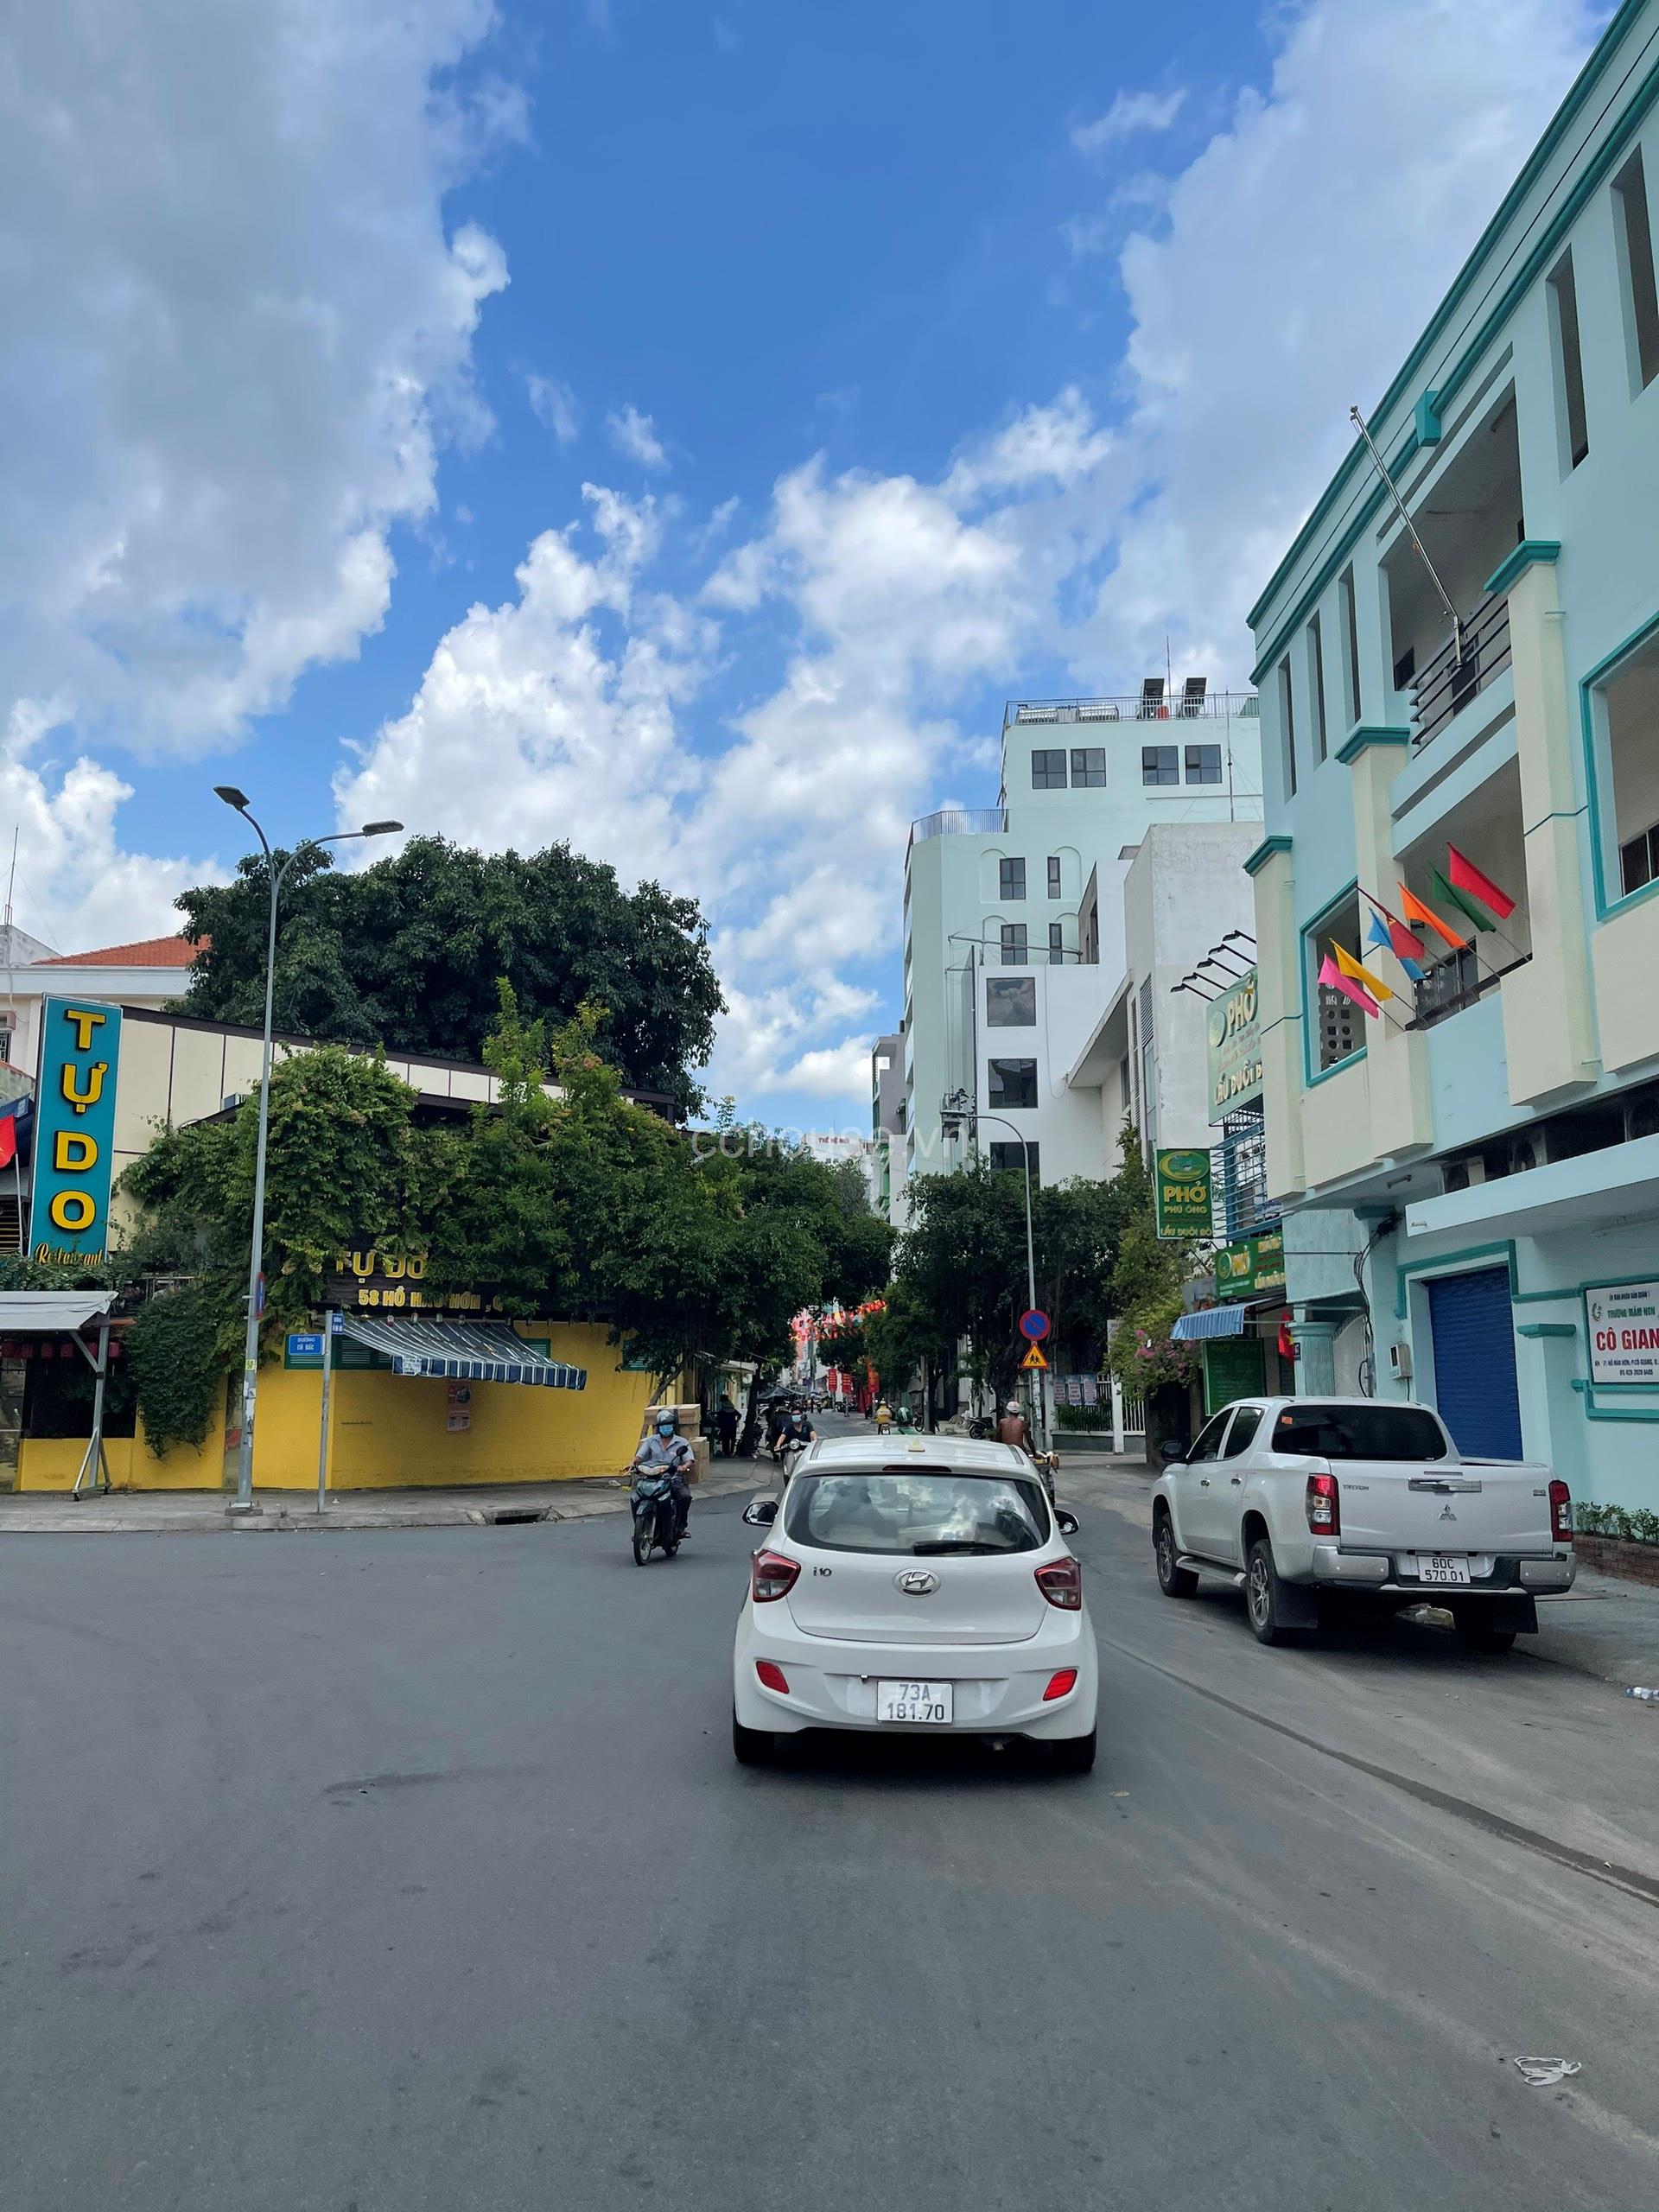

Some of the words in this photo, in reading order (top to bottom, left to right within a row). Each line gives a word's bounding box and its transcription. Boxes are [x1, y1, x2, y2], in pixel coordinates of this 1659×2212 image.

[1227, 973, 1257, 1037] PHỞ
[62, 1009, 108, 1115] TỰ
[51, 1130, 99, 1231] DO
[1163, 1180, 1206, 1204] PHỞ
[1164, 1205, 1183, 1214] PHÚ
[1185, 1204, 1208, 1214] ÔNG
[359, 1289, 379, 1306] 58
[383, 1286, 405, 1306] HỒ
[1643, 1306, 1656, 1316] NON
[1596, 1326, 1617, 1351] CÔ
[1622, 1327, 1659, 1351] GIAN
[813, 1566, 833, 1577] i10
[1425, 1569, 1464, 1582] 570.01
[899, 1684, 931, 1701] 73A
[887, 1702, 944, 1720] 181.70
